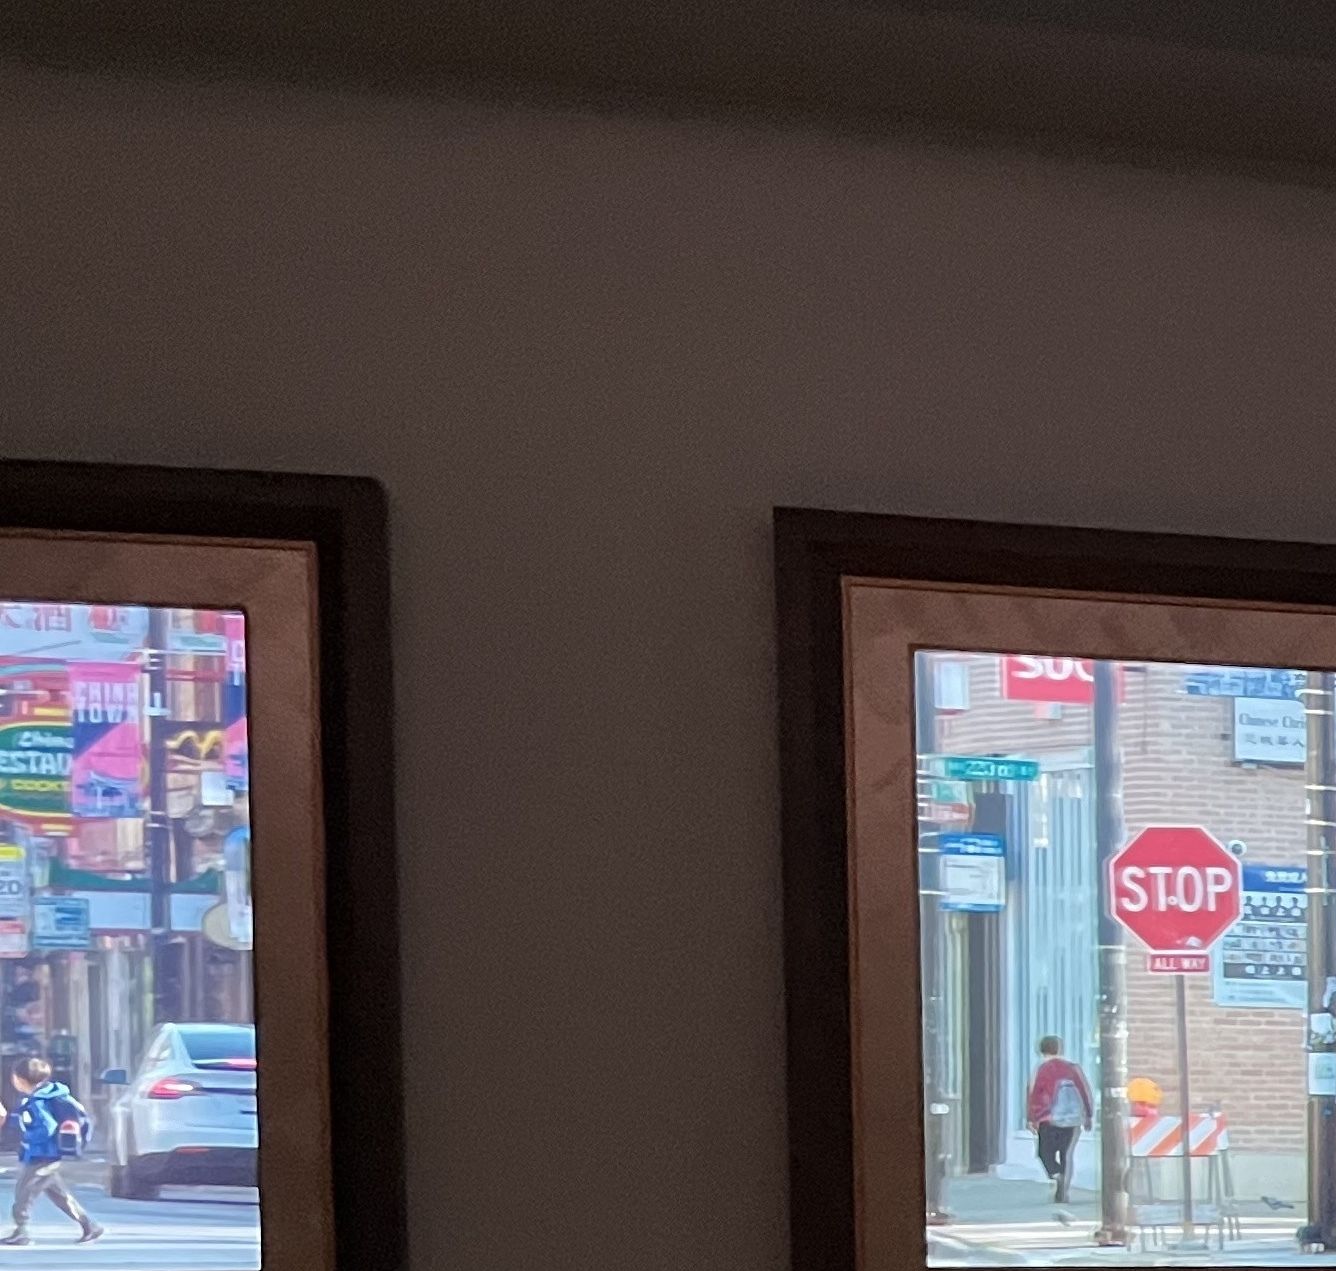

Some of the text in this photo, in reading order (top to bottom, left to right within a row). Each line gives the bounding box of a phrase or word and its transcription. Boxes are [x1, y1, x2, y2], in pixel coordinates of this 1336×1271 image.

[73, 681, 139, 704] CHINA
[1119, 865, 1234, 912] STOP
[1153, 957, 1208, 970] ALL WAY
